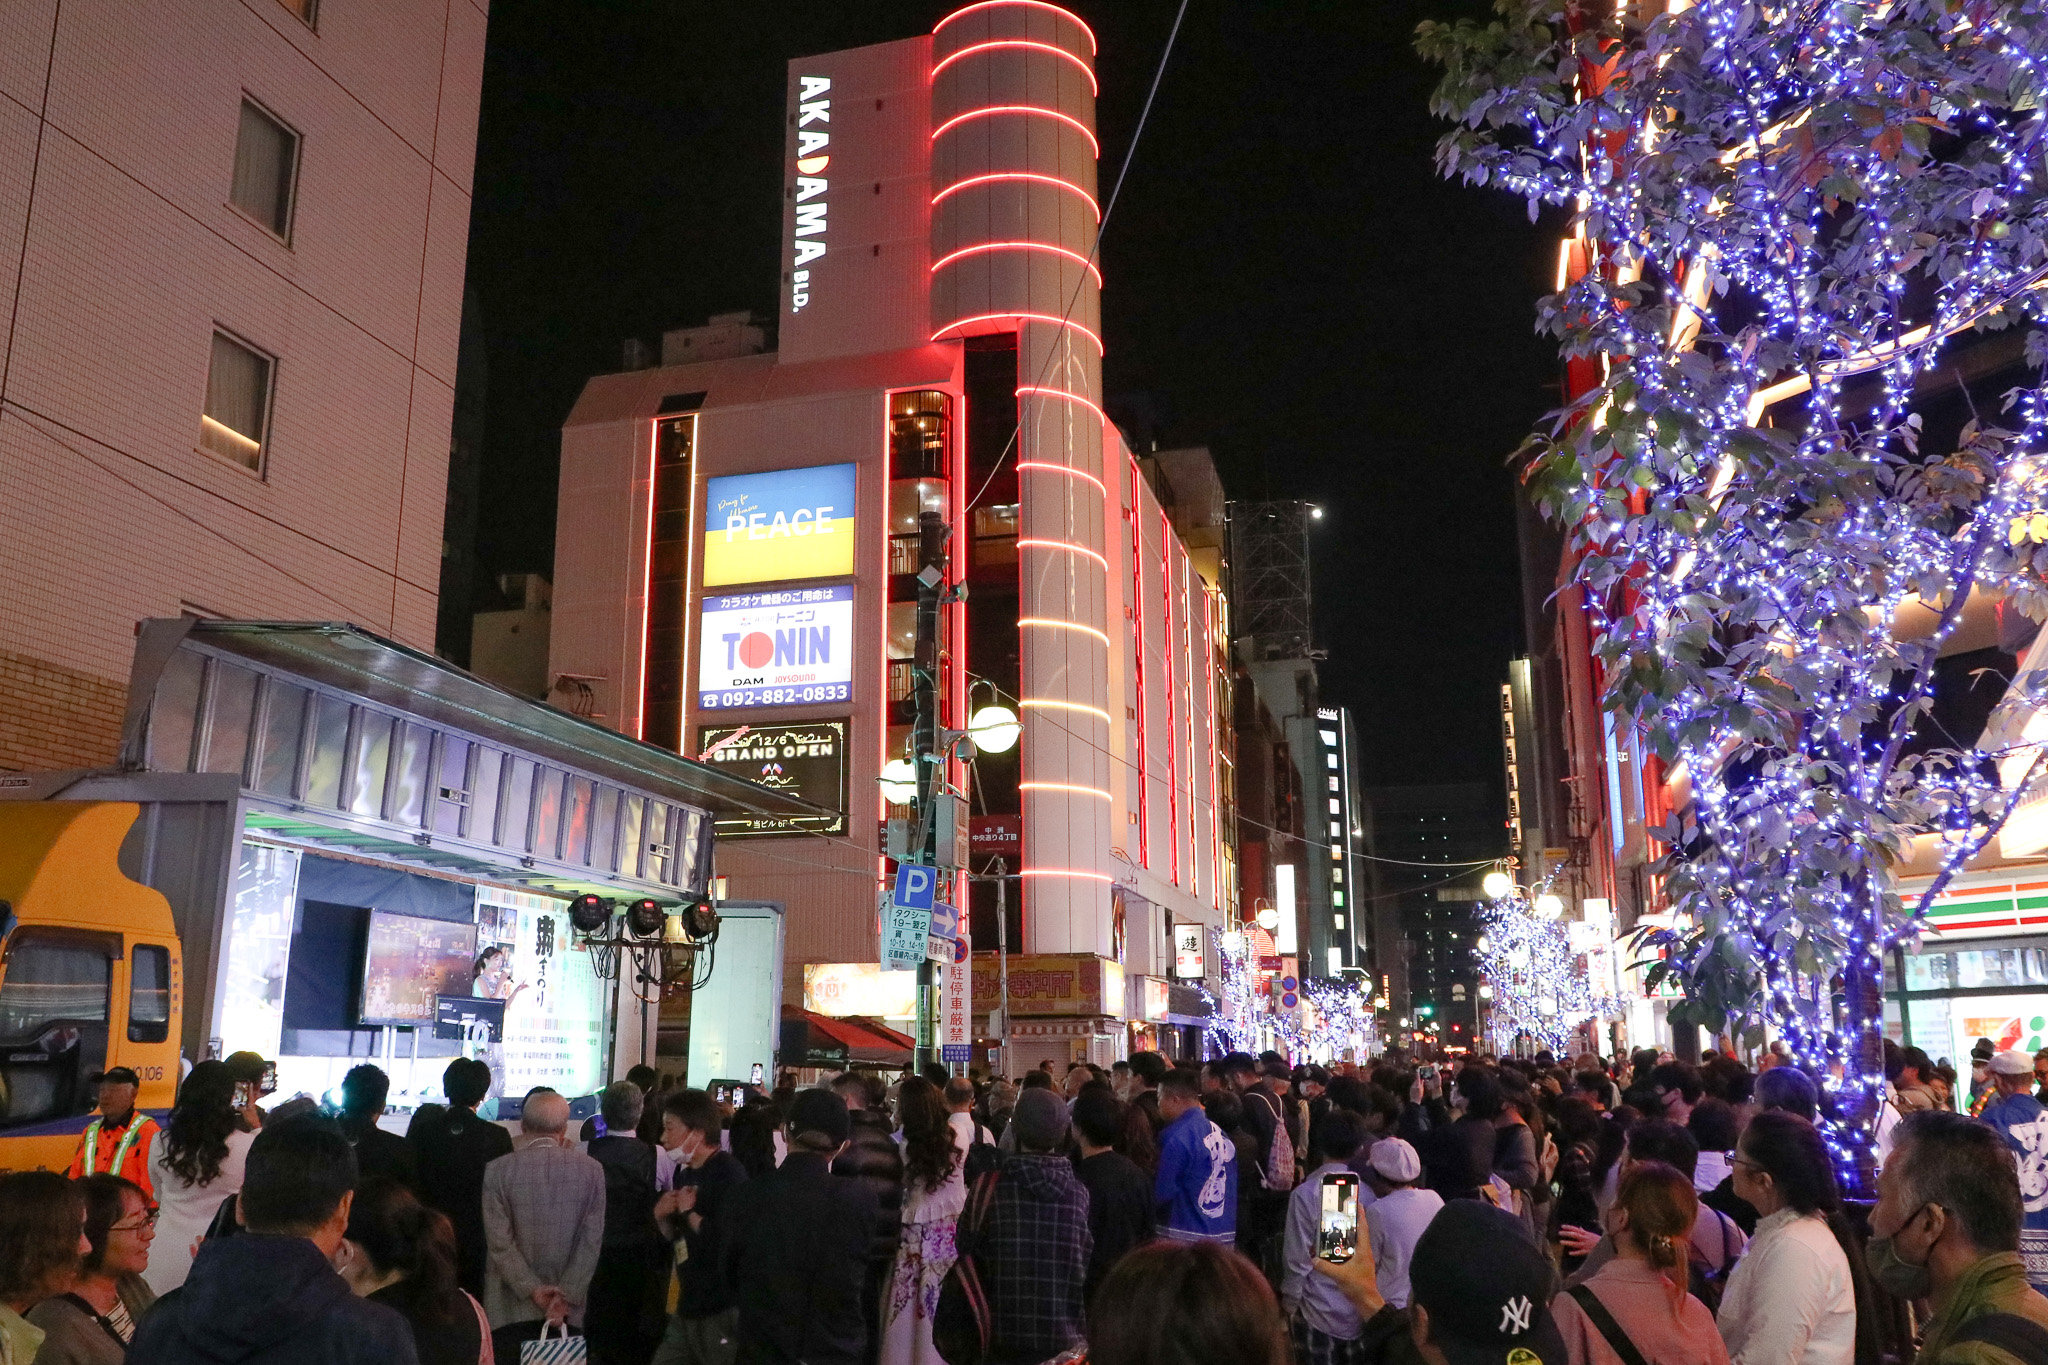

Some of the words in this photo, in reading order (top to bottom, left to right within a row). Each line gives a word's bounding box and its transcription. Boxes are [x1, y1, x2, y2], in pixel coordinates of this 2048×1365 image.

[797, 76, 831, 267] AKADAMA
[793, 270, 810, 314] BLD.
[726, 506, 834, 543] PEACE
[720, 589, 834, 609] カラオケ機器のご用命は
[776, 610, 816, 624] トーニン
[722, 625, 831, 671] TONIN
[733, 677, 764, 687] DAM
[774, 674, 816, 684] JOYSOUND
[722, 685, 848, 707] 092-882-0833
[713, 747, 778, 762] GRAND
[783, 744, 833, 758] OPEN
[758, 735, 787, 746] 12/6
[904, 869, 929, 903] P
[895, 909, 926, 919] タクシー
[949, 966, 964, 1041] 駐停車厳禁
[1498, 1295, 1533, 1335] NY
